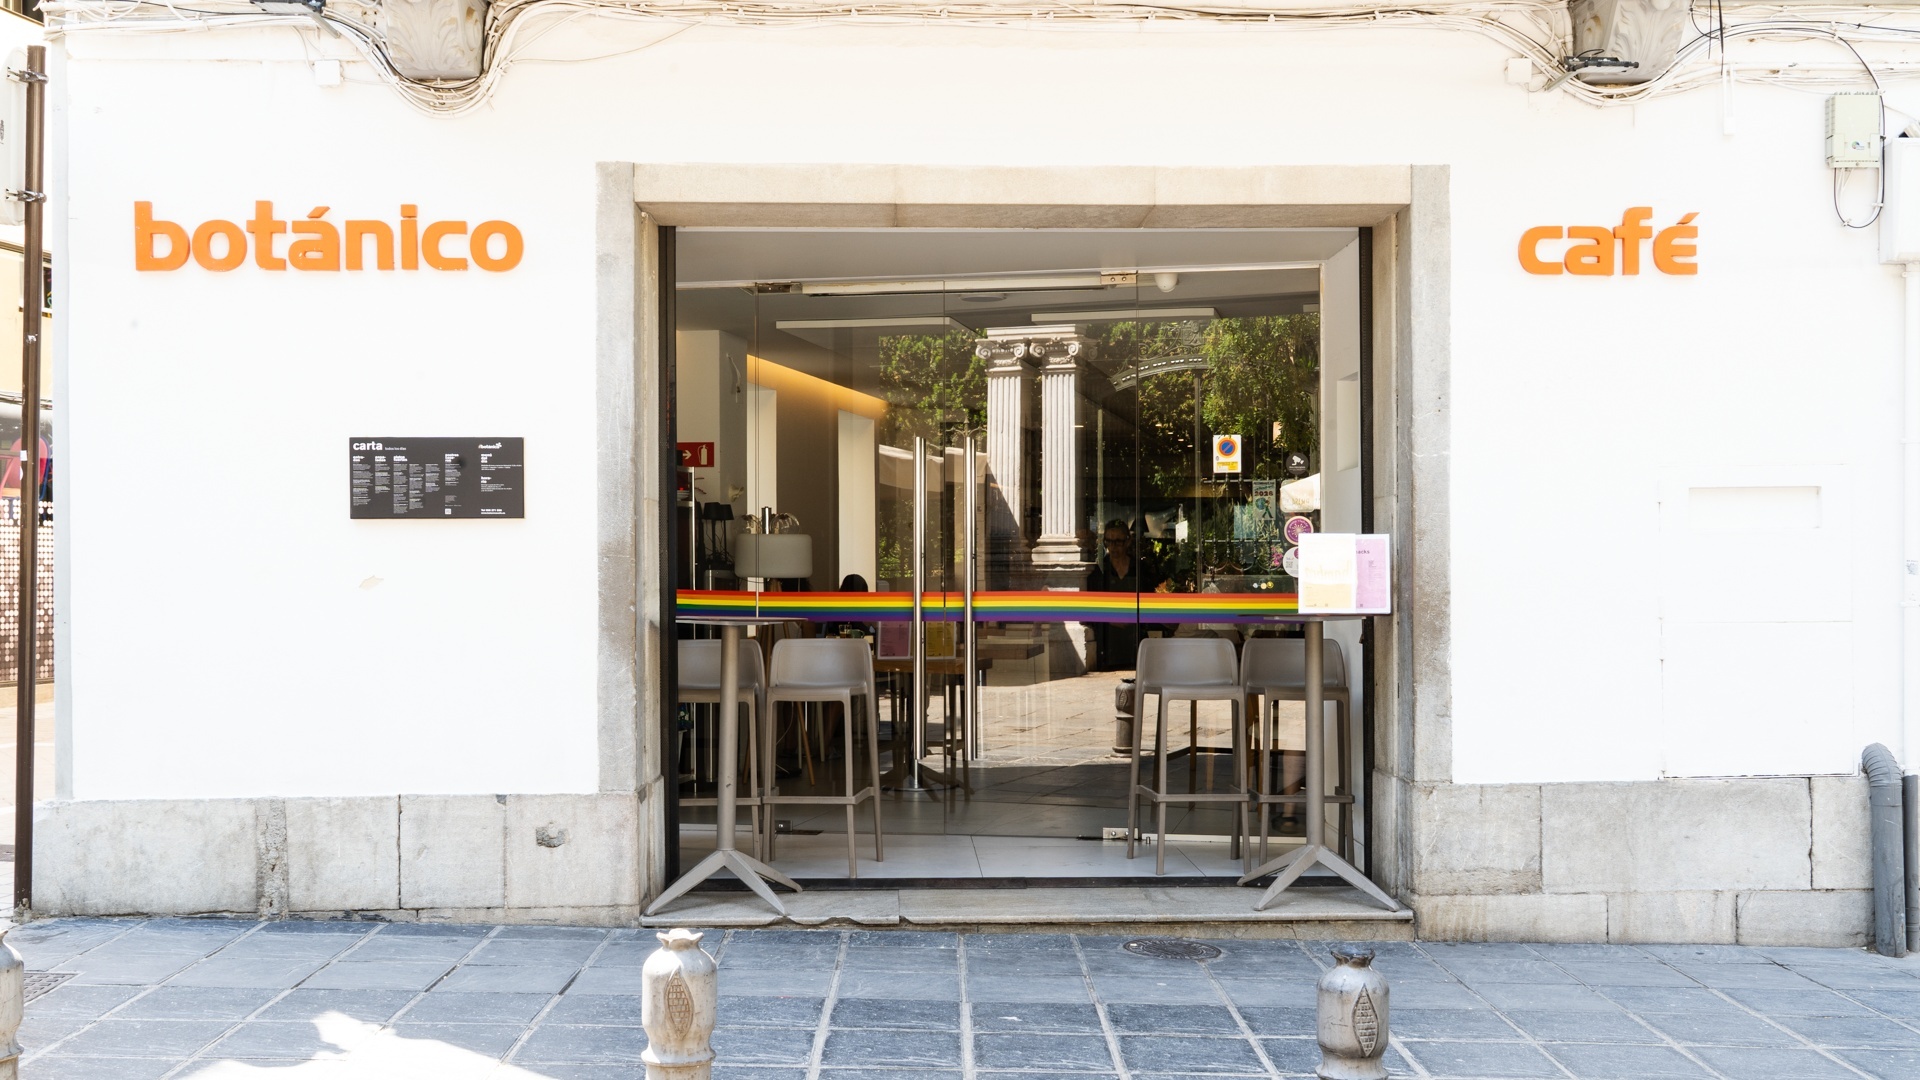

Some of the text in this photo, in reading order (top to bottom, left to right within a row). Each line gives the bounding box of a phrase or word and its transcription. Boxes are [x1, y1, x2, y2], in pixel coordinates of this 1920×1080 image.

[134, 201, 524, 272] botánico
[1518, 206, 1700, 276] café
[353, 441, 383, 450] carta
